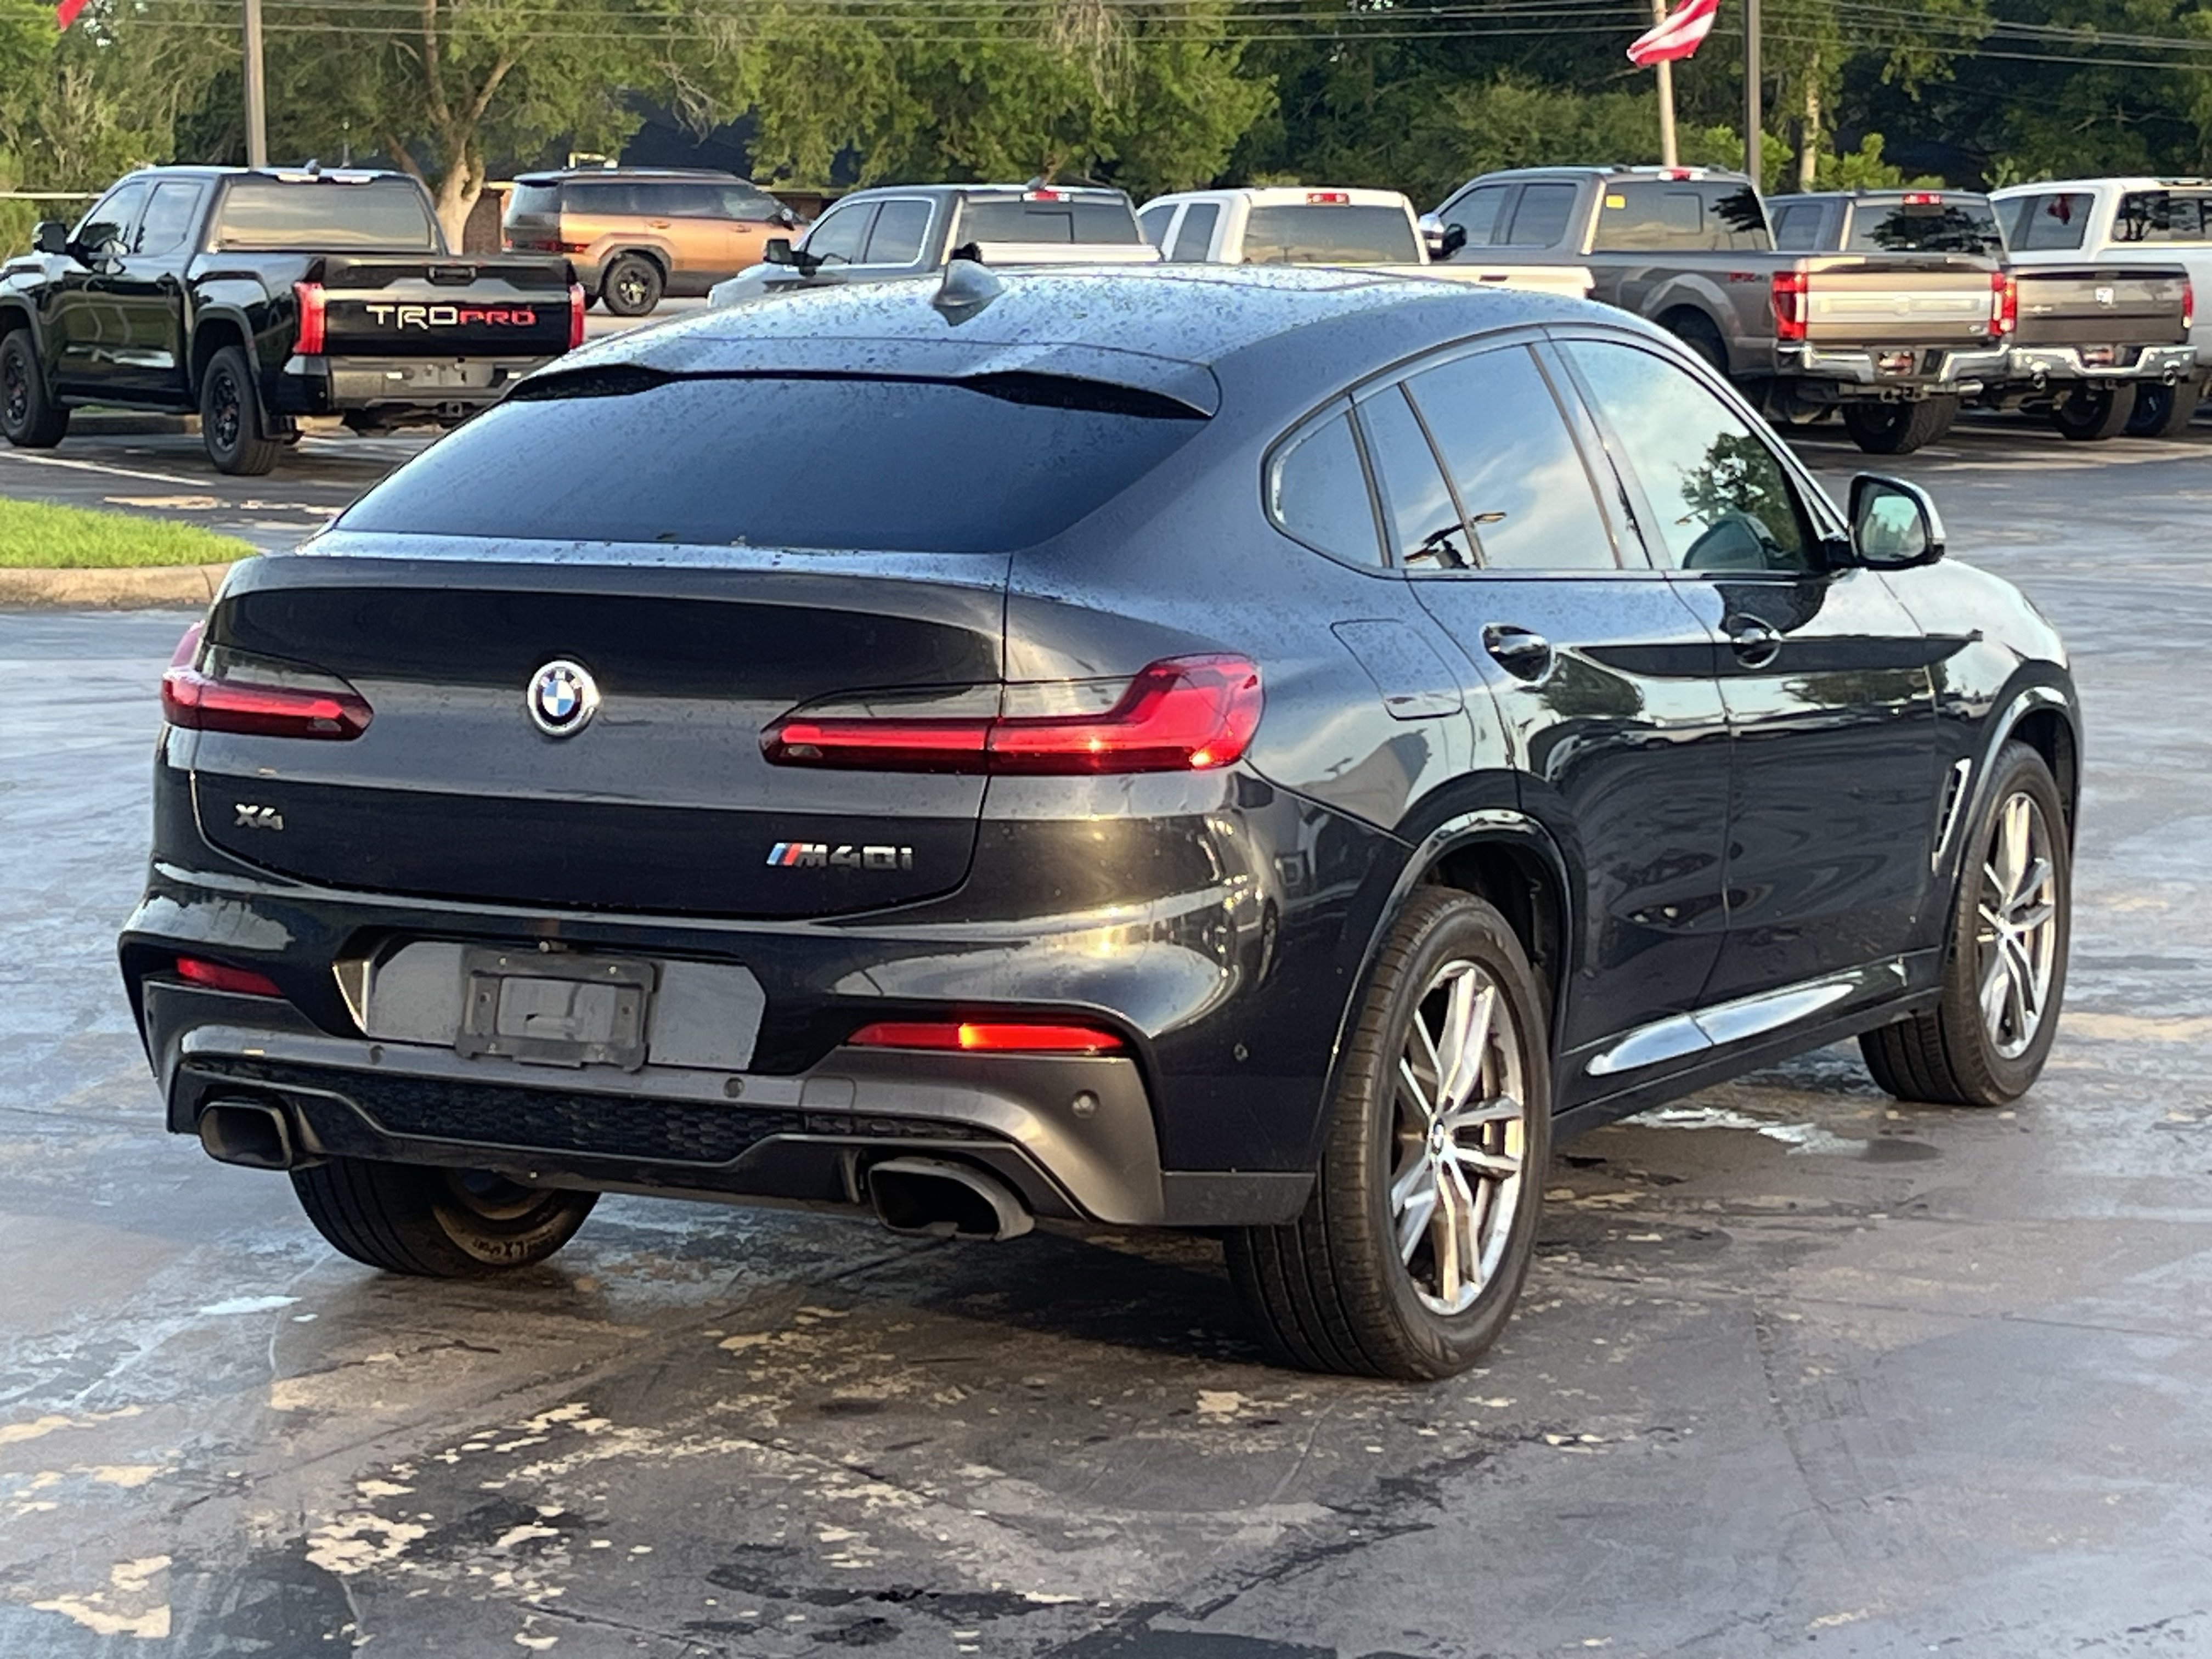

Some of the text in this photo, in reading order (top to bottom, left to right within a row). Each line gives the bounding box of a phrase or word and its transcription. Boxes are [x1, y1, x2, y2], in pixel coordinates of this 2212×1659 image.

[459, 309, 537, 325] PRO
[234, 803, 284, 831] X4
[793, 843, 912, 871] M40i
